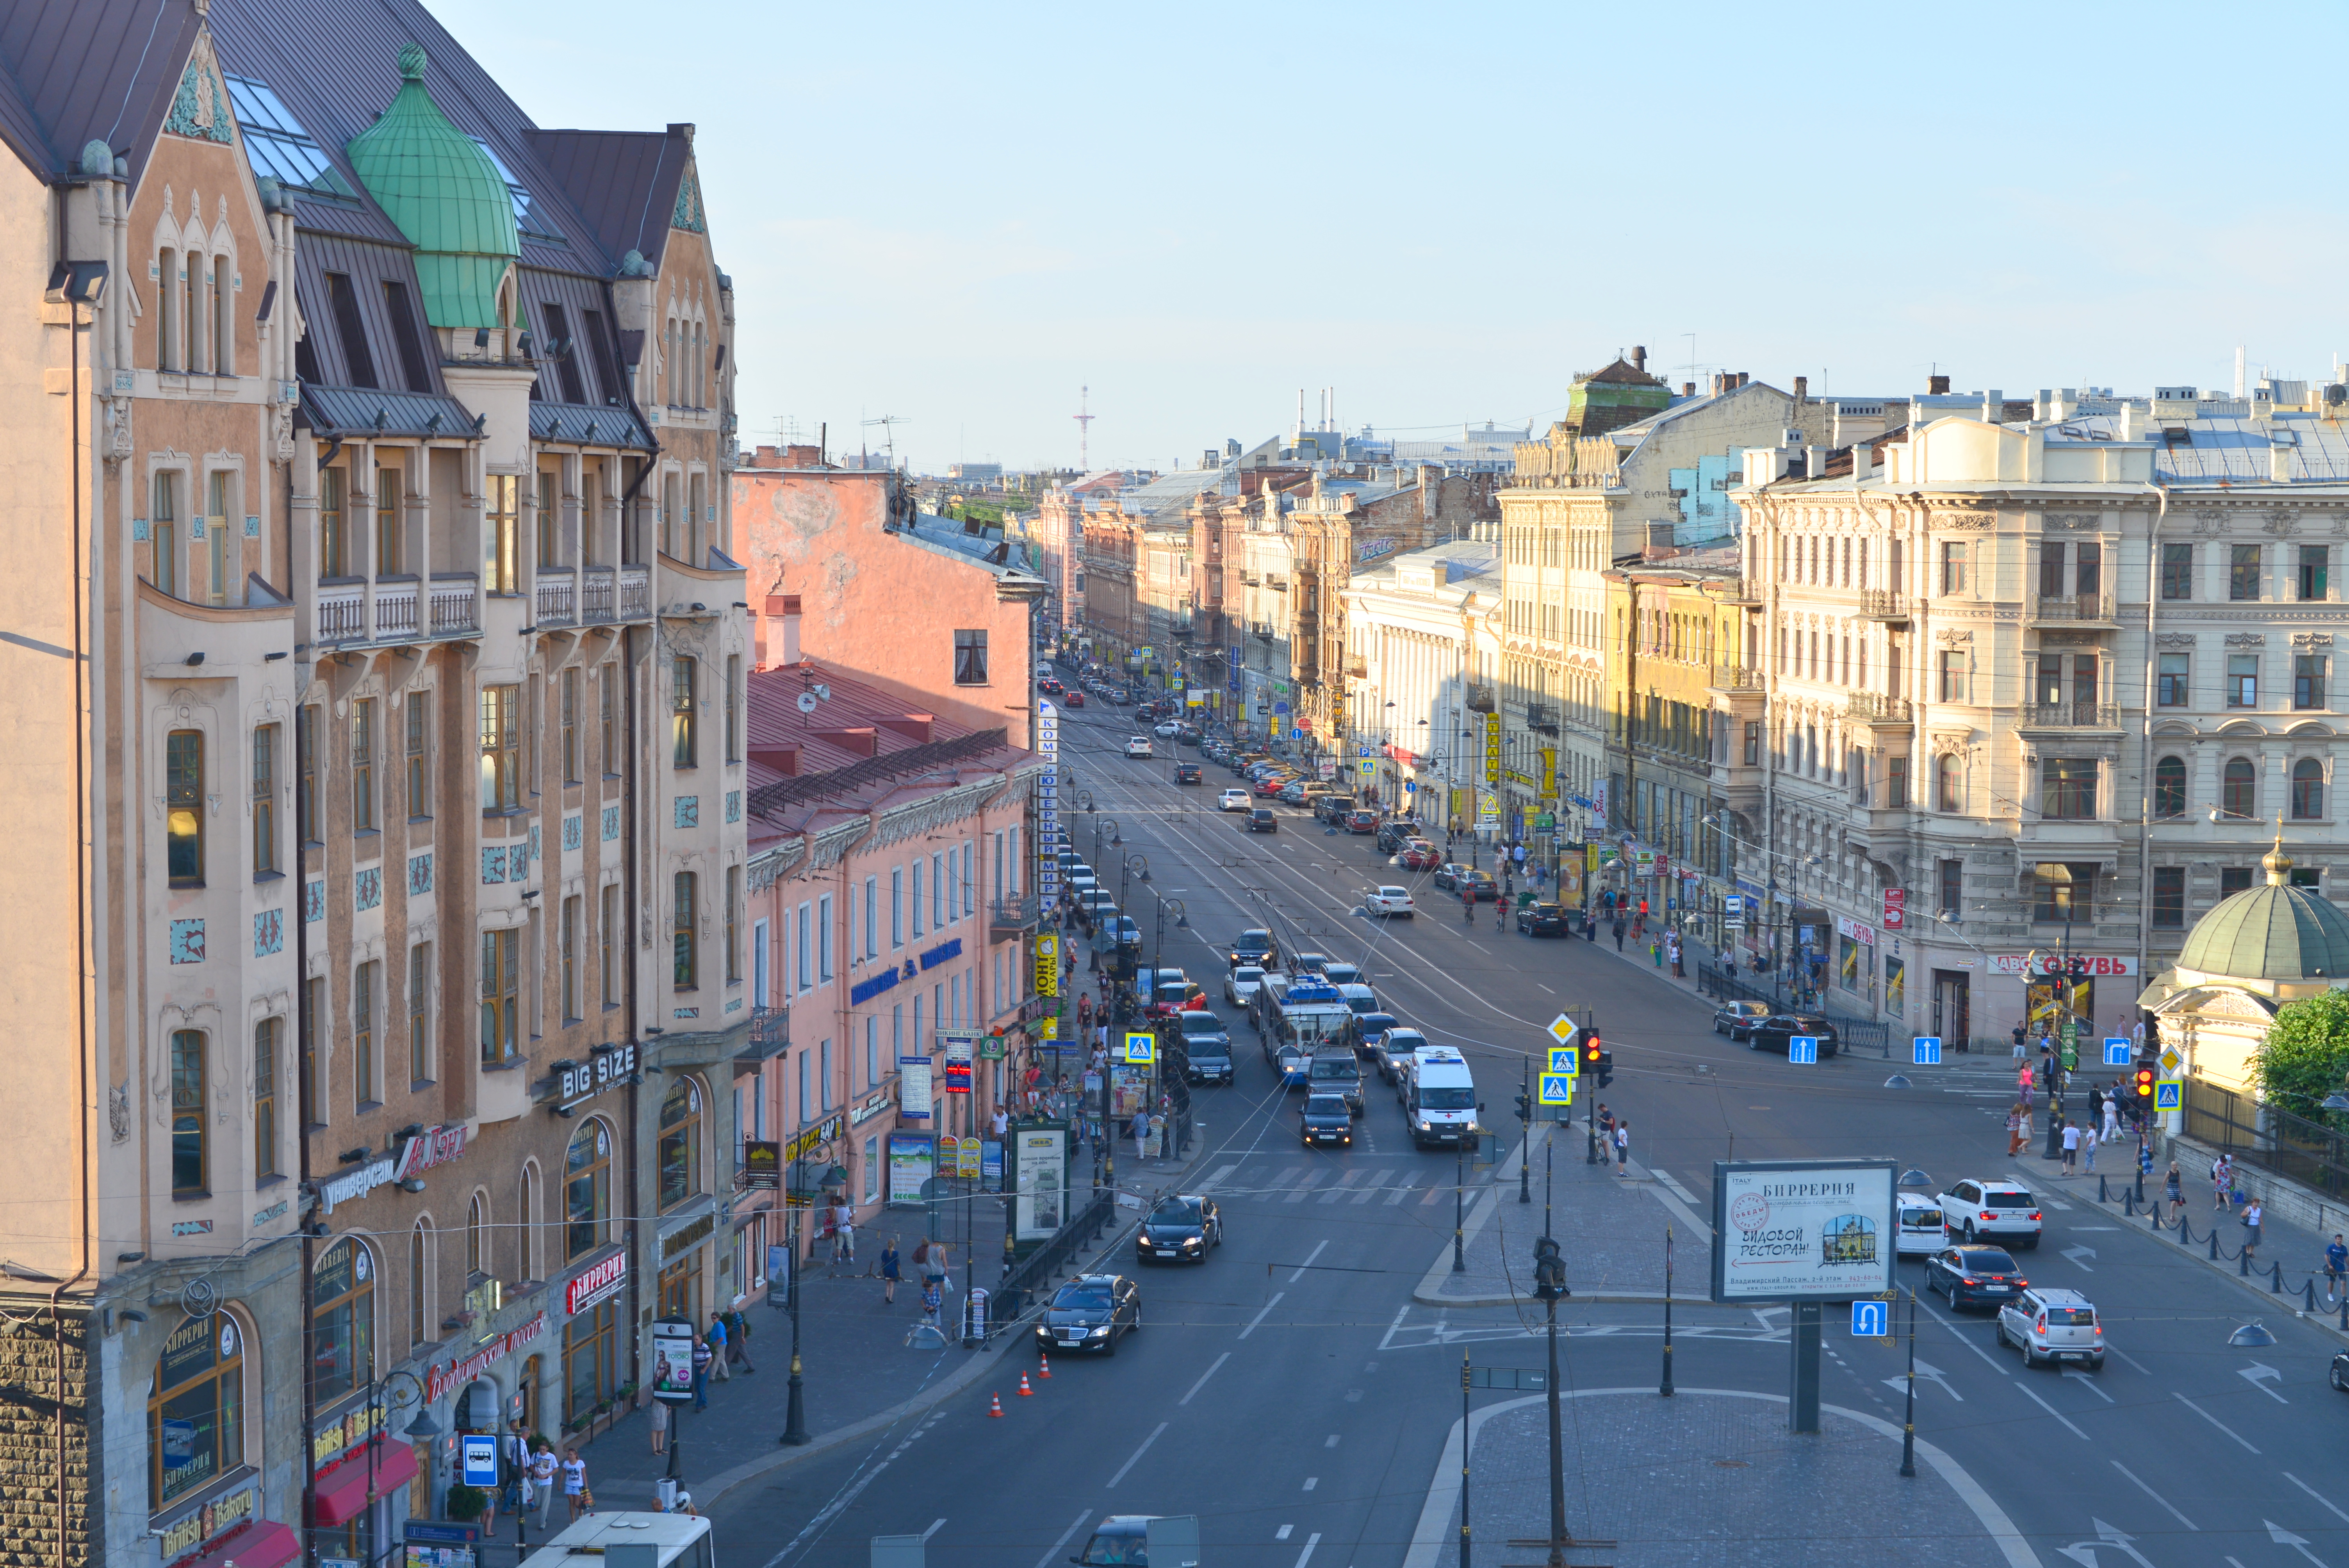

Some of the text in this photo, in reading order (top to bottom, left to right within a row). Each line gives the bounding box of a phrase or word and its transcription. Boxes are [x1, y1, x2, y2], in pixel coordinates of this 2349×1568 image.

[1042, 720, 1054, 853] КОМПЬЮТЕРНЫЙ
[1593, 789, 1606, 819] Solvex
[1043, 862, 1054, 893] МИР
[1853, 923, 1873, 944] ОБУВЬ
[2041, 1003, 2055, 1014] ЛЕТО
[563, 1046, 634, 1099] BIG SIZE
[597, 1074, 631, 1096] BY DIPLOMAT
[820, 1119, 835, 1143] БАР
[424, 1126, 468, 1170] Лэнд
[326, 1159, 393, 1215] универсам
[1763, 1182, 1856, 1197] БИРРЕРИЯ
[1736, 1206, 1764, 1219] ОБЕДЫ
[1766, 1195, 1851, 1212] гастрономический паб
[1742, 1226, 1803, 1242] ВИДОВОЙ
[1741, 1243, 1809, 1256] РЕСТОРАН!
[576, 1252, 626, 1300] БИРРЕРИЯ
[1731, 1276, 1780, 1285] Владимирский
[166, 1319, 209, 1354] БИРРЕРИЯ
[428, 1311, 546, 1402] Владимирский пассаж
[314, 1425, 343, 1463] British
[165, 1451, 210, 1488] БИРРЕРИЯ
[163, 1489, 252, 1558] British Bakery
